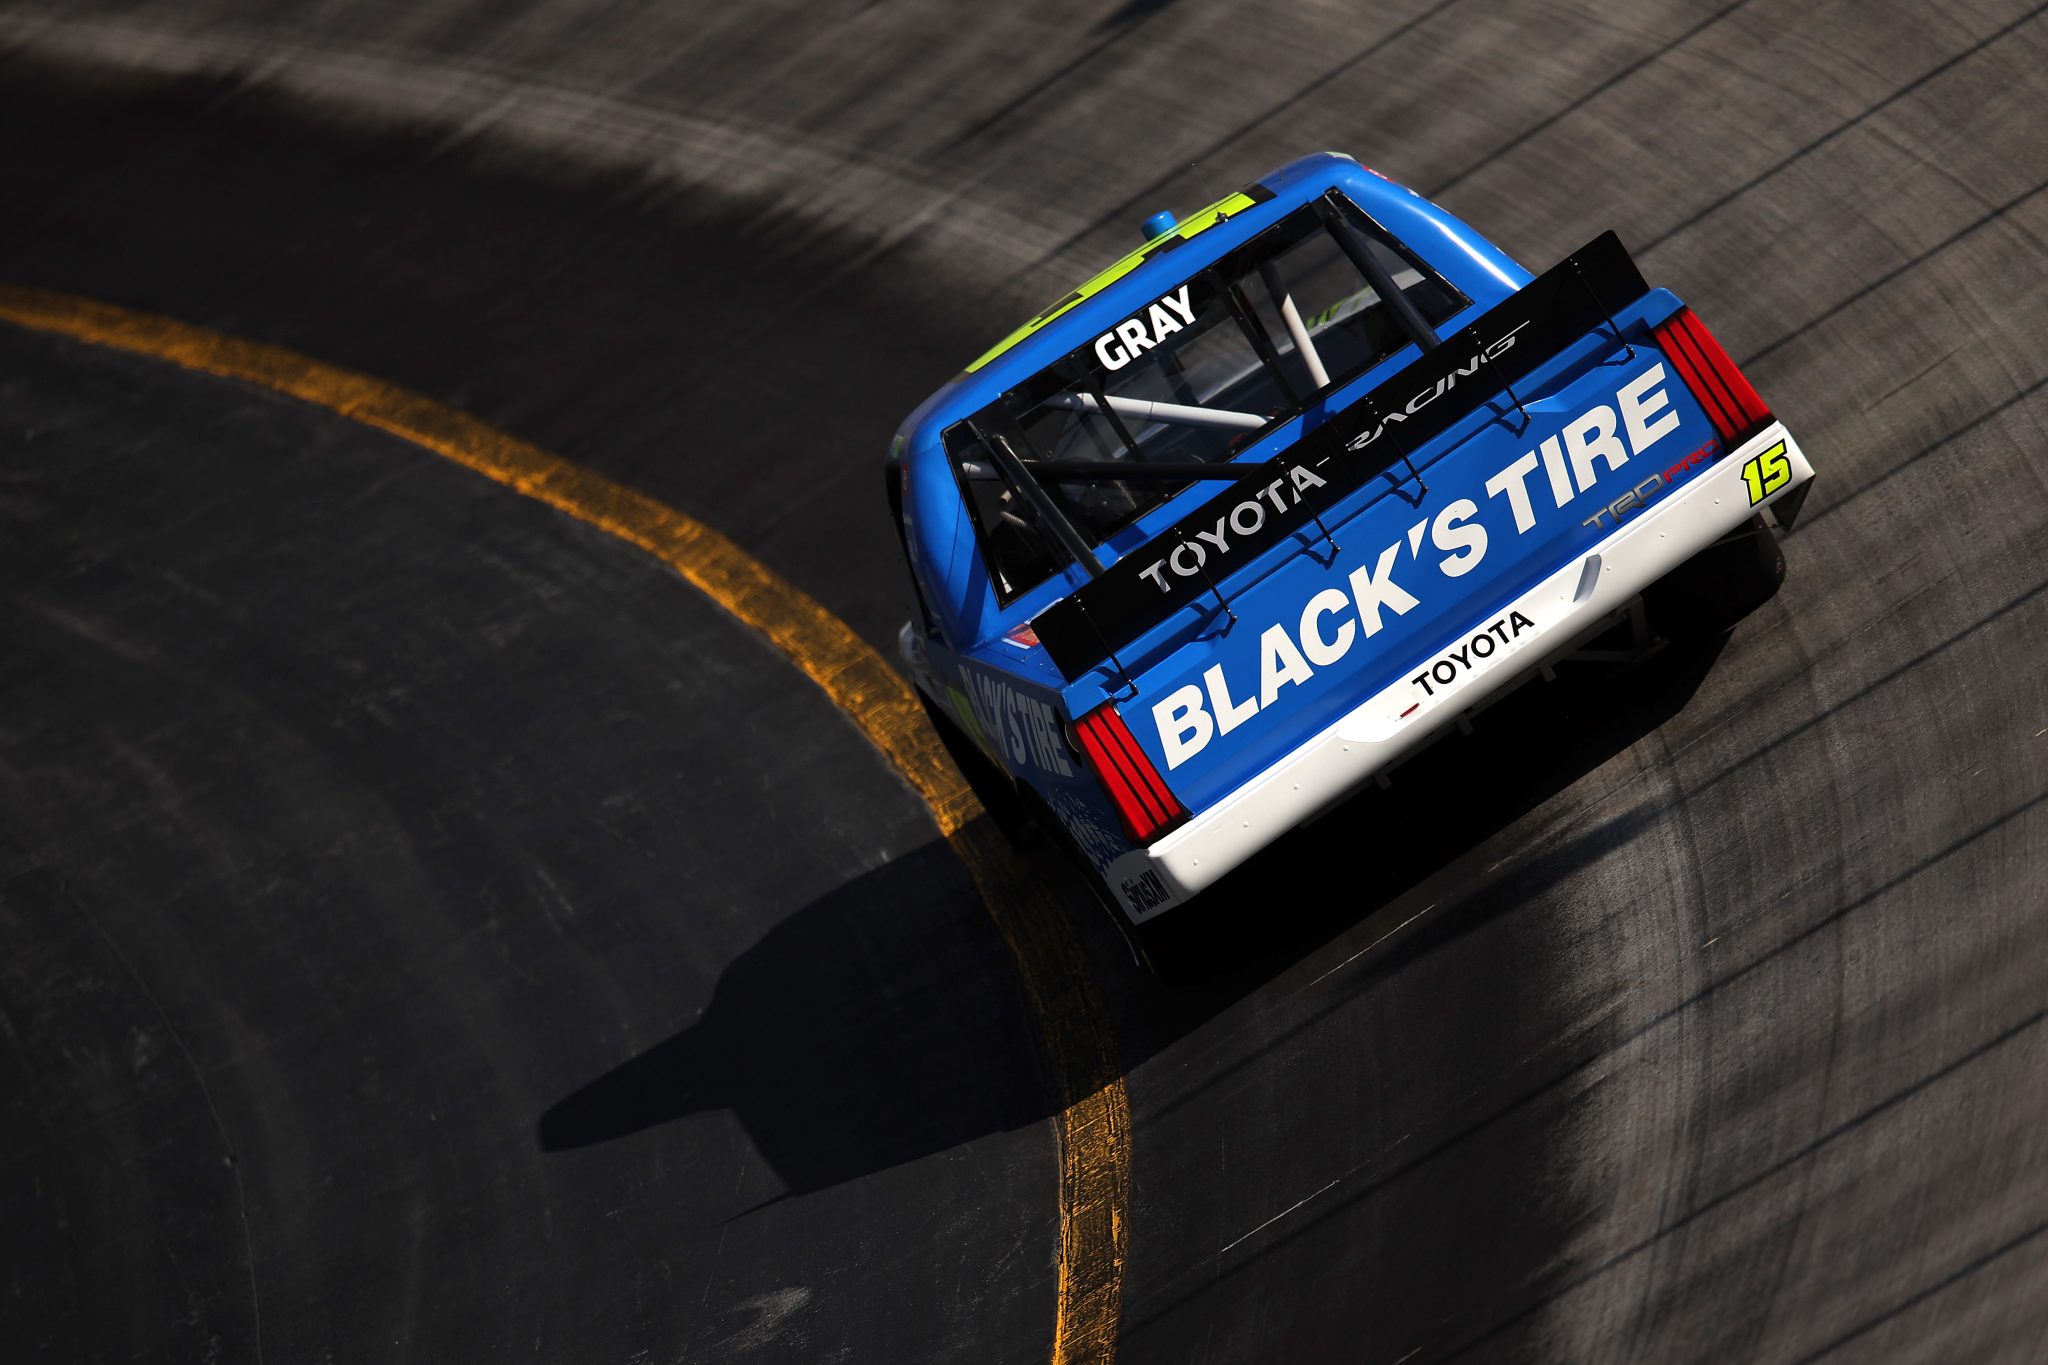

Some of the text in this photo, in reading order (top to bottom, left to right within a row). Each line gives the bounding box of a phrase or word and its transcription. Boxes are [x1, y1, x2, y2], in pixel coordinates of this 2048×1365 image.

[1094, 285, 1200, 371] GRAY
[1138, 320, 1530, 594] TOYOTA RACING
[1582, 439, 1720, 530] TRD PRO
[1740, 438, 1792, 507] 15
[1151, 361, 1681, 771] BLACK'S TIRE
[1411, 611, 1535, 696] TOYOTA
[1015, 691, 1074, 778] TIRE
